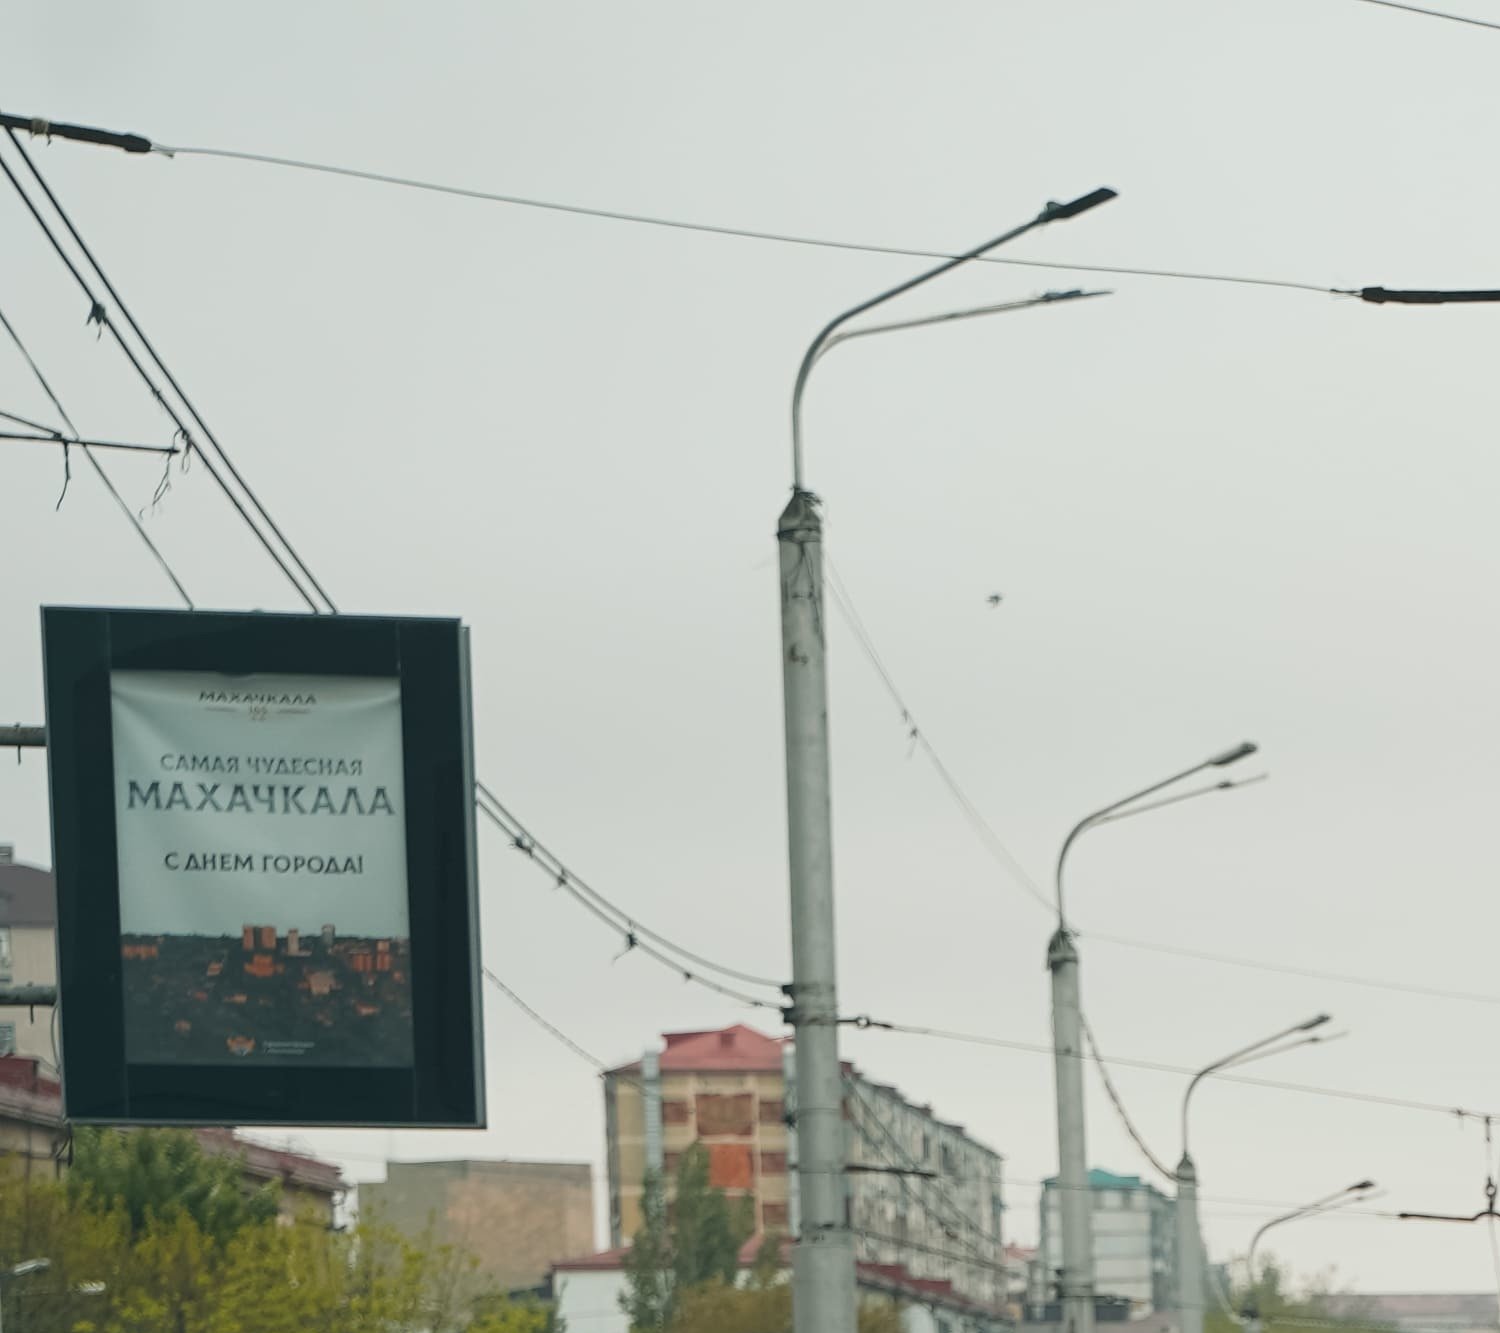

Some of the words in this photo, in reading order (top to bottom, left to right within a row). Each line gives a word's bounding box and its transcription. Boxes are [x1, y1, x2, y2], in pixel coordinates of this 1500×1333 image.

[160, 754, 239, 774] САМАЯ
[246, 756, 363, 776] ЧУДЕСНАЯ
[126, 780, 397, 816] МАХАЧКАЛА
[165, 852, 178, 871] С
[184, 853, 253, 872] ДНЕМ
[262, 855, 363, 874] ГОРОДА!
